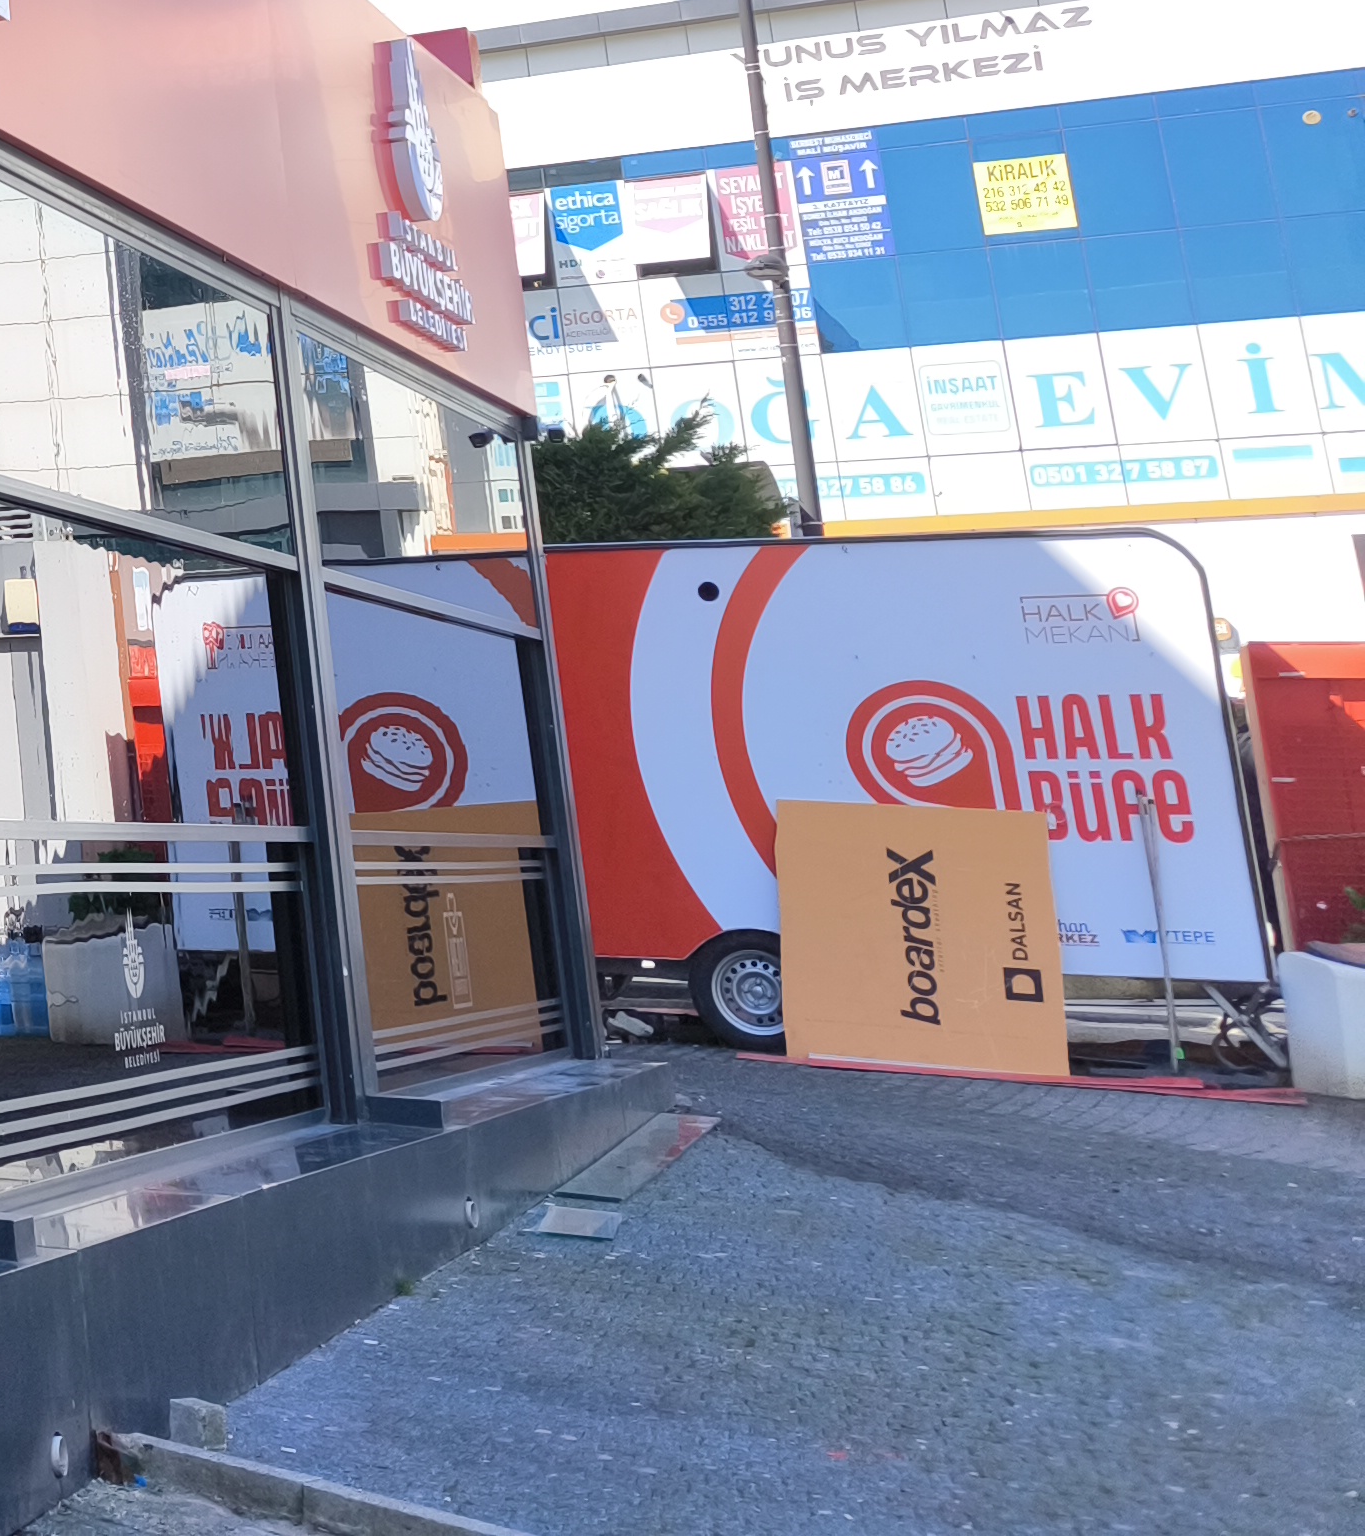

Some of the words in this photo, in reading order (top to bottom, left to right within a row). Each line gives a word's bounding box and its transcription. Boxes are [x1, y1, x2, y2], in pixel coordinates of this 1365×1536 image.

[905, 6, 1093, 47] YILMAZ
[783, 77, 825, 107] İŞ
[839, 44, 1045, 96] MERKEZİ
[719, 172, 783, 195] SEYAT
[982, 187, 1005, 199] 216
[1008, 183, 1031, 197] 312
[1033, 181, 1048, 194] 43
[555, 190, 616, 211] ethica
[730, 195, 764, 216] İŞYE
[985, 200, 1007, 213] 532
[1010, 197, 1032, 211] 506
[1035, 195, 1049, 208] 71
[555, 209, 621, 233] sigorta
[389, 241, 477, 325] BÜYÜKŞEHİR
[728, 295, 757, 311] 312
[762, 293, 774, 308] 2
[563, 307, 638, 326] SİGORTA
[687, 314, 728, 329] 0555
[731, 311, 759, 325] 412
[763, 310, 774, 322] 9
[926, 375, 998, 395] İNŞAAT
[1032, 464, 1088, 486] 0501
[1094, 461, 1140, 482] 327
[1146, 459, 1176, 479] 58
[1180, 457, 1210, 477] 87
[818, 477, 853, 496] 327
[858, 476, 886, 495] 58
[890, 474, 917, 493] 86
[1021, 603, 1103, 623] HALK
[1024, 624, 1130, 644] MEKAN
[1015, 693, 1174, 760] HALK
[1004, 882, 1029, 962] DALSAN
[1057, 918, 1091, 934] han
[120, 1007, 157, 1025] İSTANBUL
[114, 1021, 166, 1052] BÜYÜKŞEHİR
[124, 1048, 161, 1069] BELEDİYESİ
